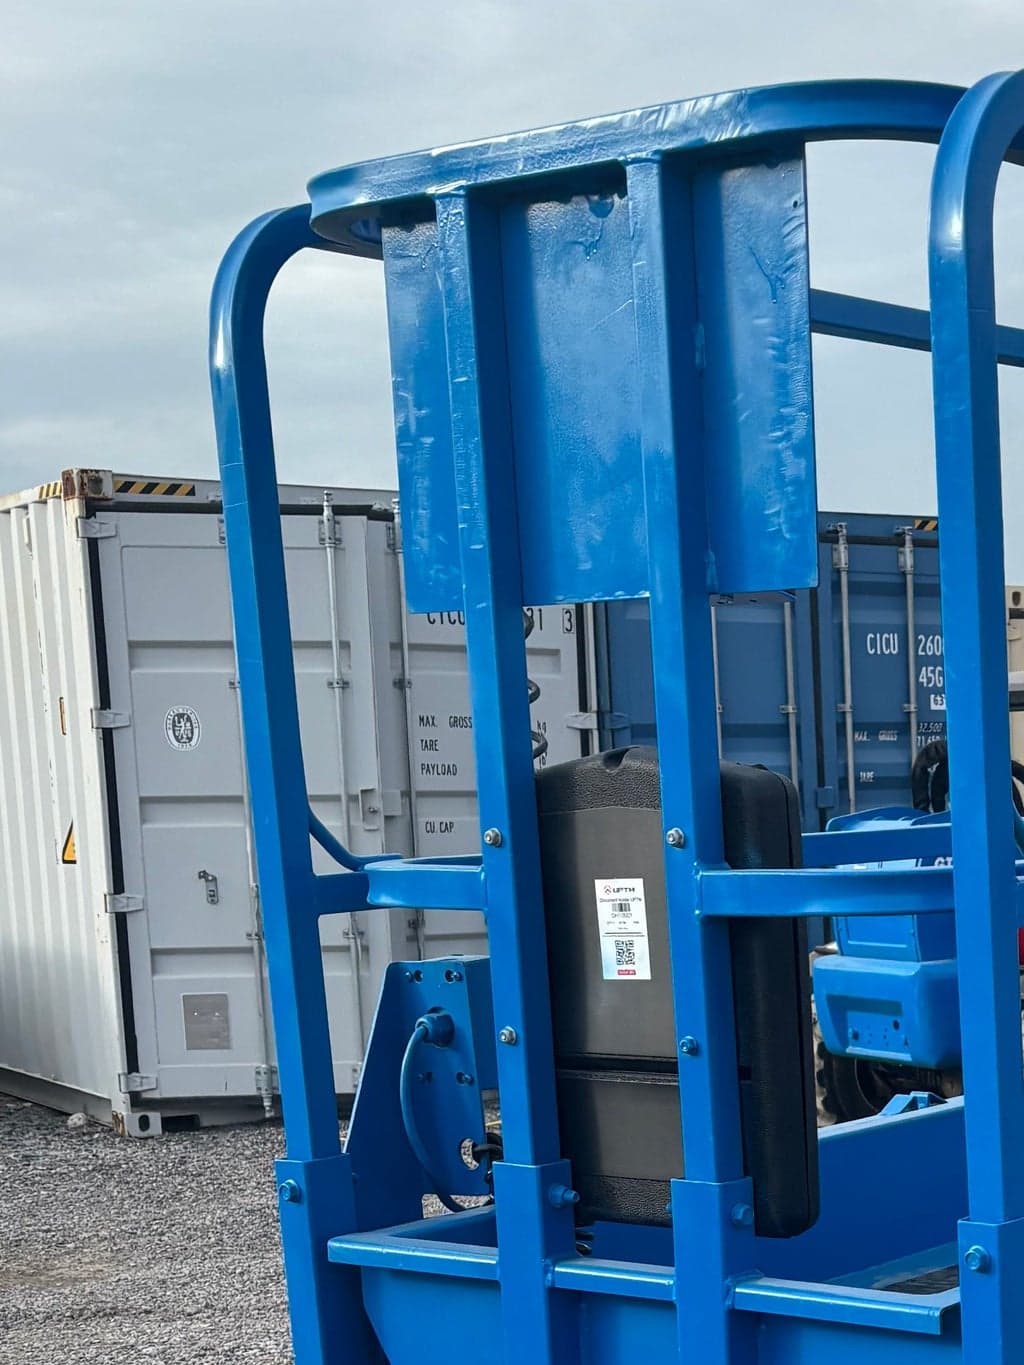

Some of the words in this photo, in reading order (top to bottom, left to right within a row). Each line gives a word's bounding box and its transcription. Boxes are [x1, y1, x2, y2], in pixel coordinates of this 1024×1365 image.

[866, 633, 898, 655] CICU
[918, 635, 945, 656] 260
[449, 716, 473, 729] GROSS
[420, 739, 439, 752] TARE
[421, 763, 458, 777] PAYLOAD
